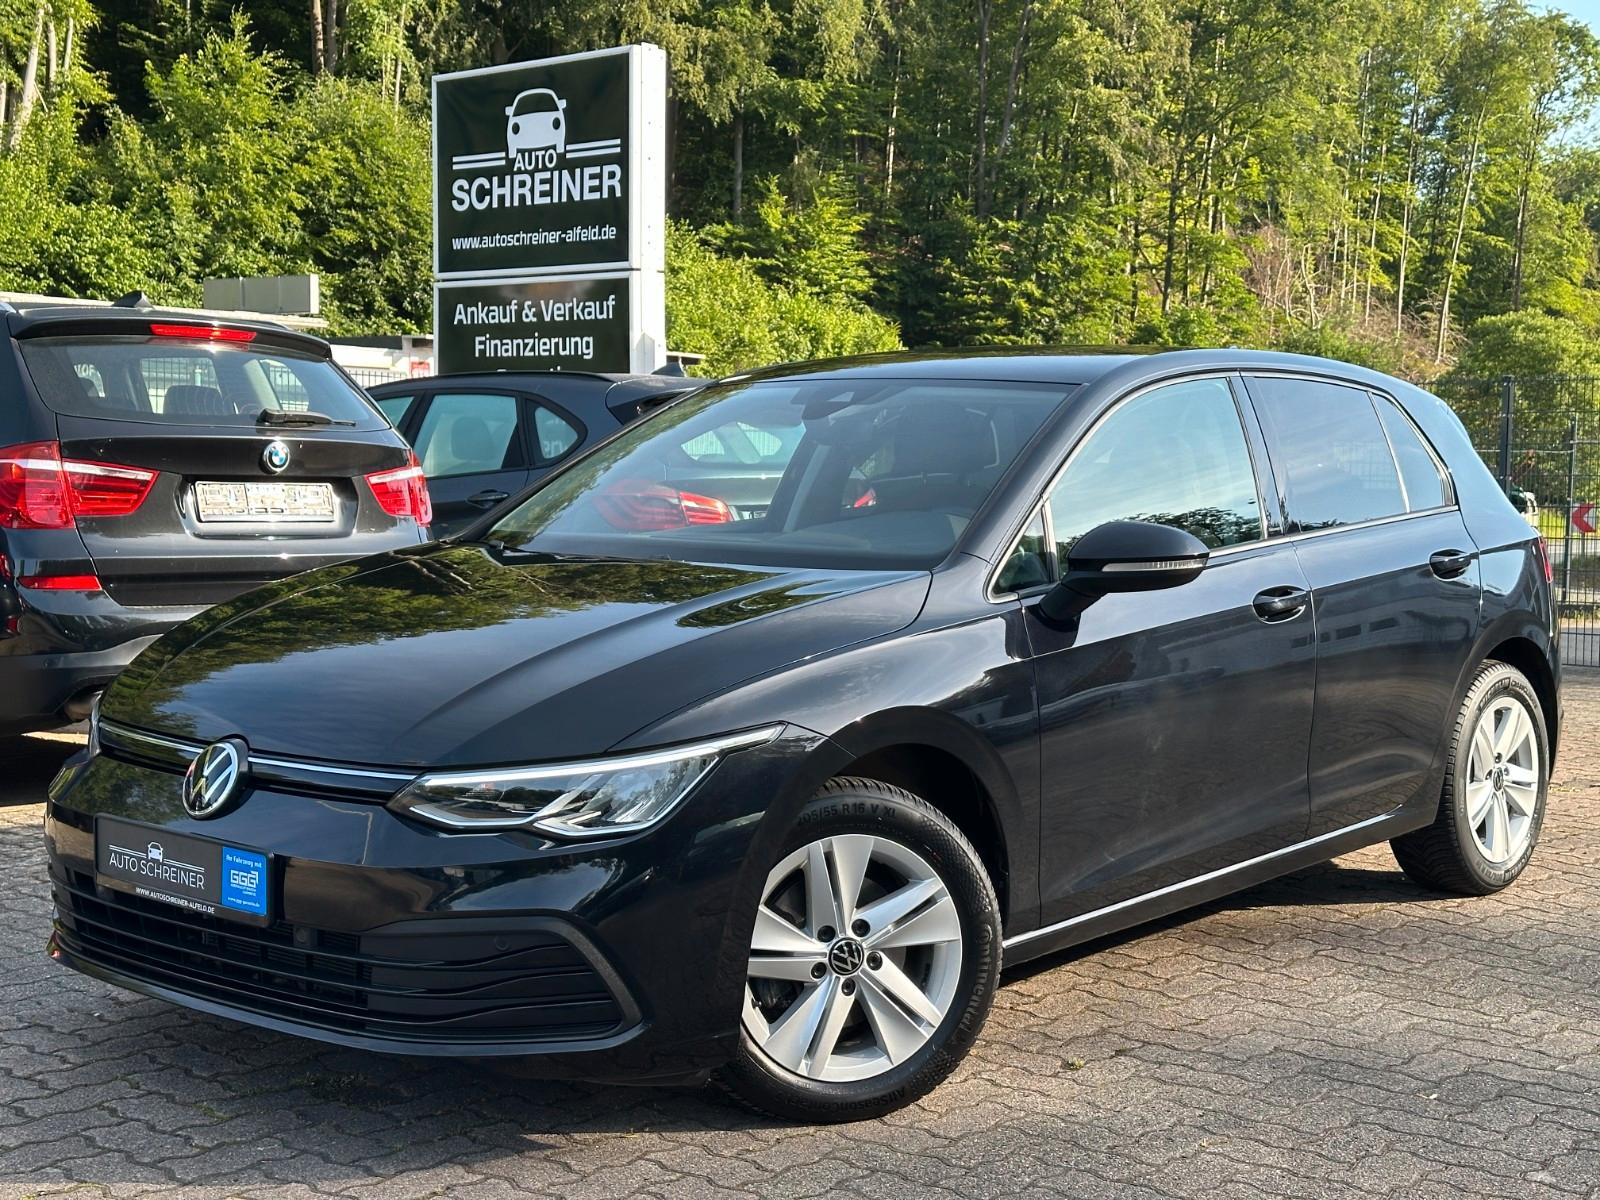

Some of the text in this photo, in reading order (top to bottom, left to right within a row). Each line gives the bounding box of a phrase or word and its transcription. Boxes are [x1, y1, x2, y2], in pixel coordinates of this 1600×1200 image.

[513, 149, 557, 171] AUTO
[451, 163, 622, 212] SCHREINER
[452, 224, 617, 250] www.autoschreiner-alfeld.de
[453, 295, 616, 326] Ankauf & Verkauf
[474, 331, 594, 359] Finanzierung
[109, 852, 138, 872] AUTO
[140, 860, 205, 890] SCHREINER
[231, 869, 259, 889] GGG
[135, 886, 215, 914] WWW.AUTOSCHREINER-ALFELD.DE
